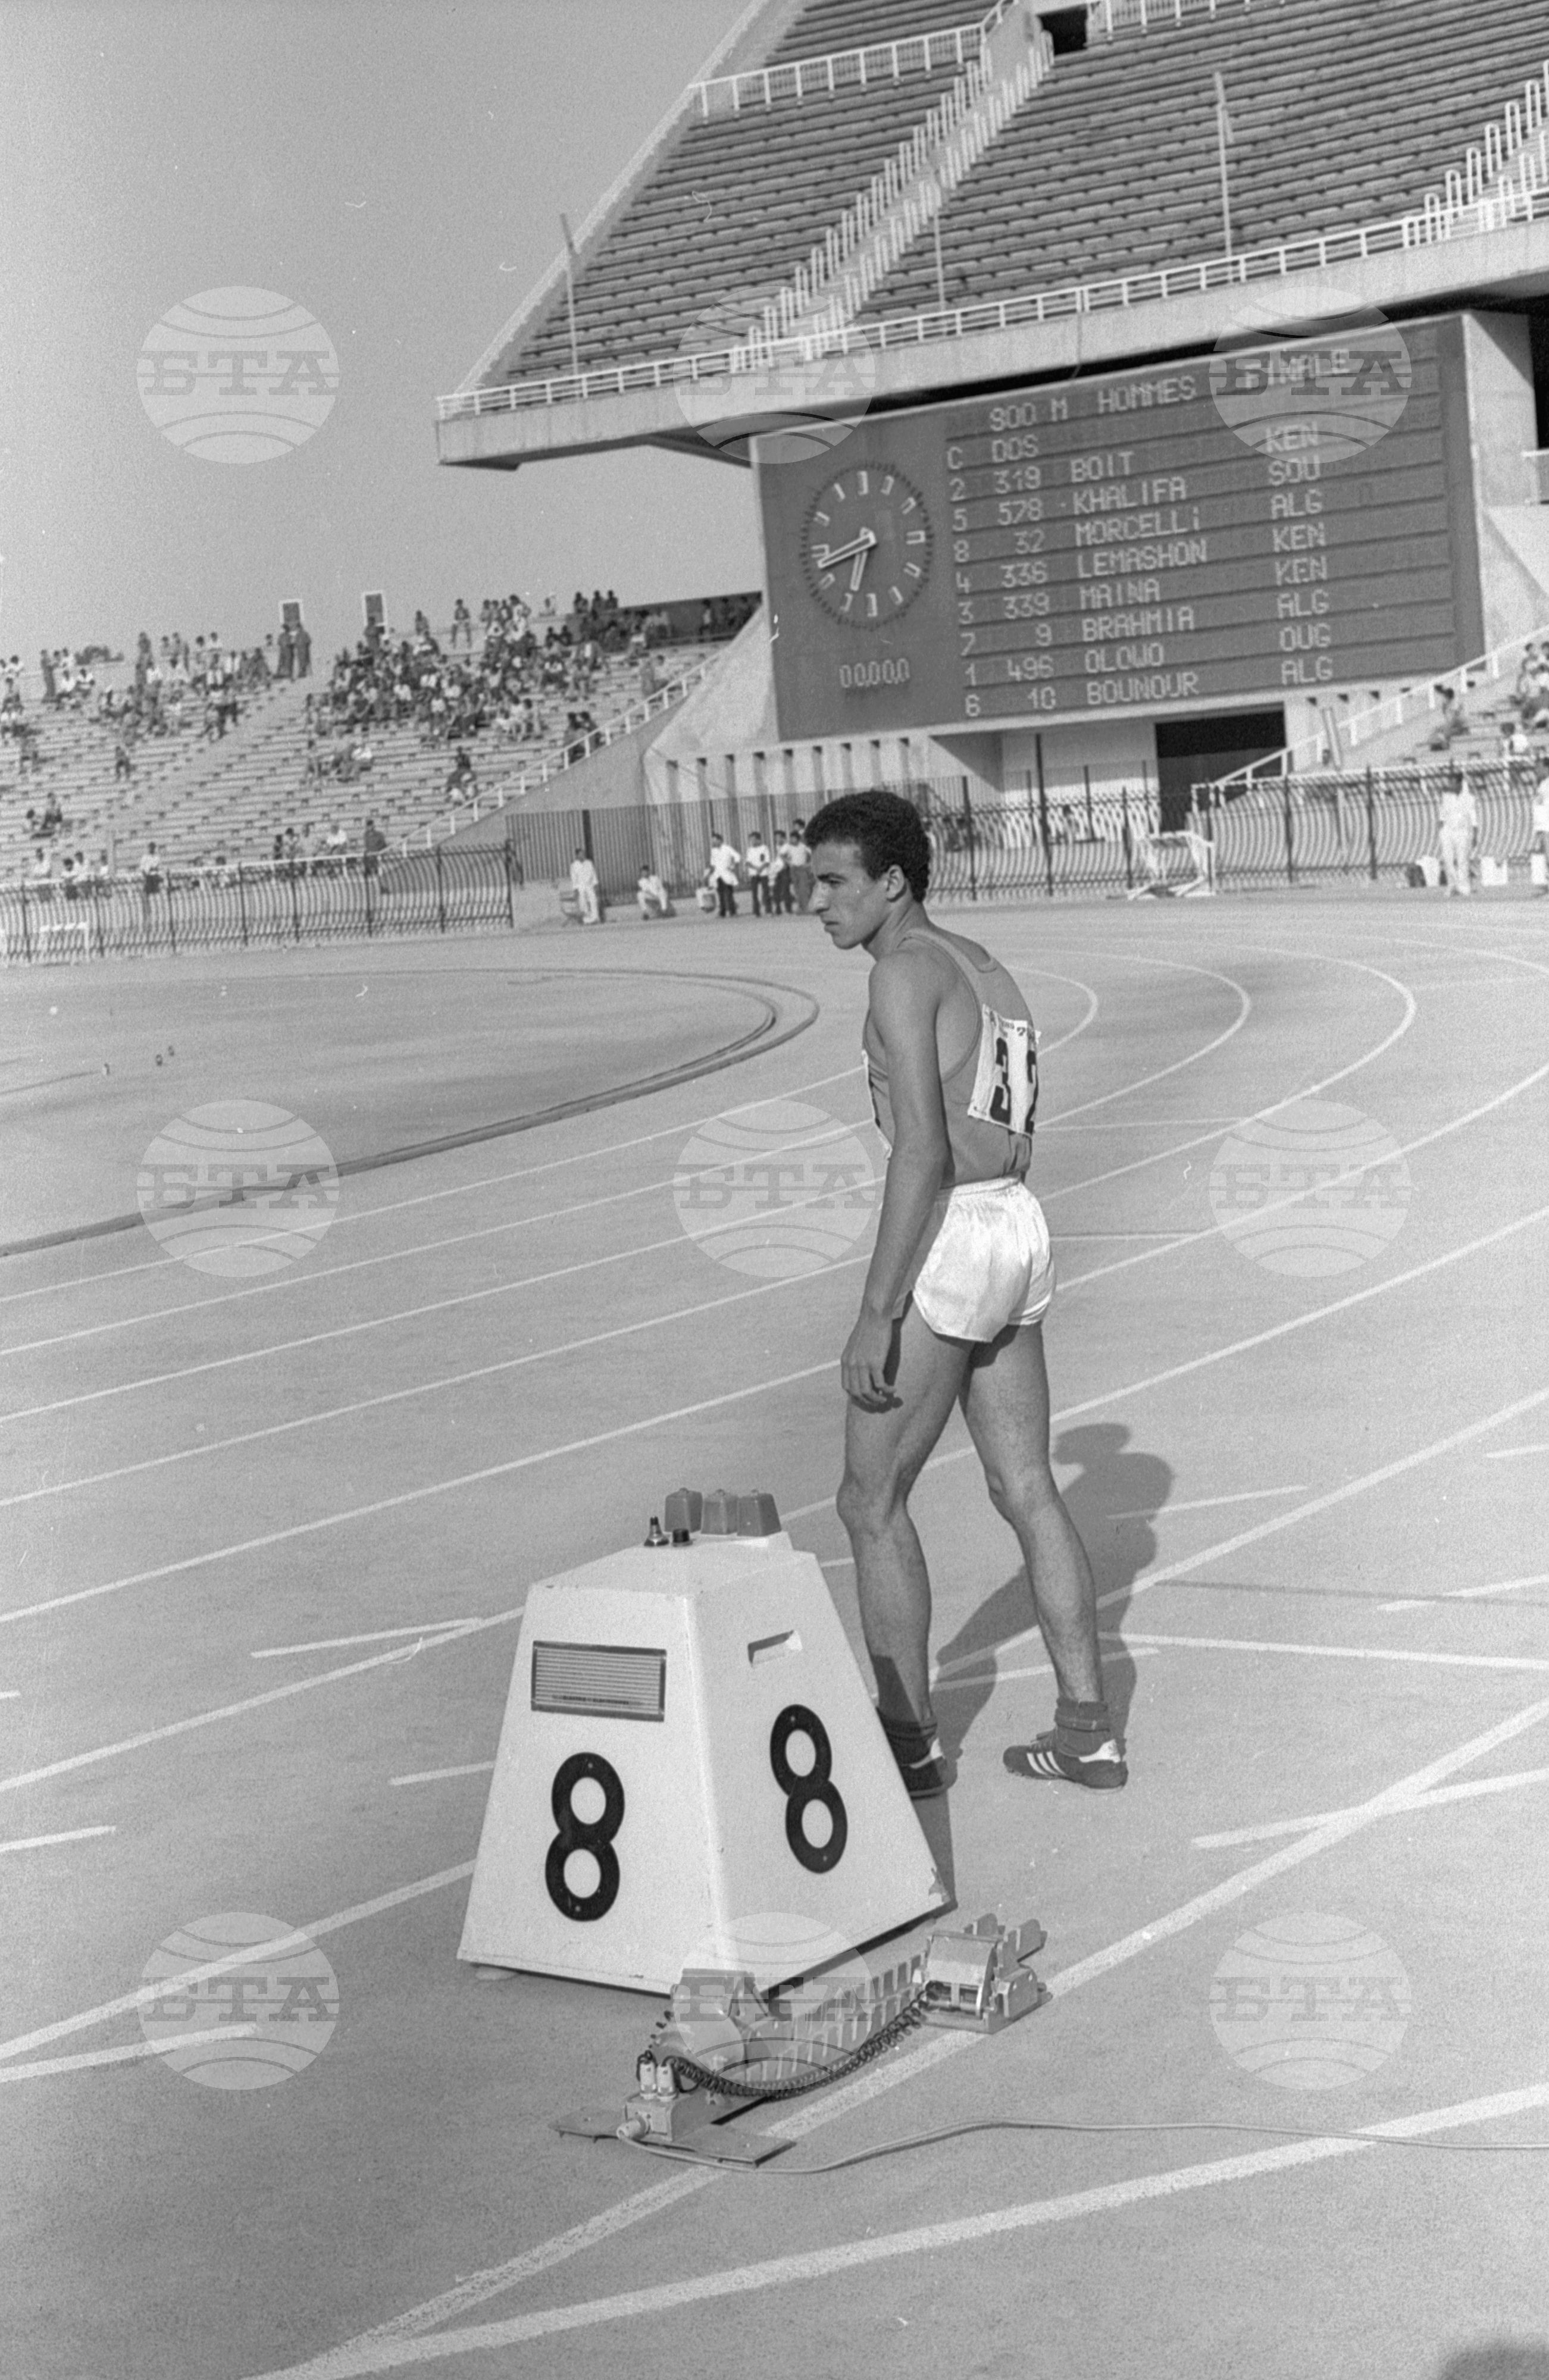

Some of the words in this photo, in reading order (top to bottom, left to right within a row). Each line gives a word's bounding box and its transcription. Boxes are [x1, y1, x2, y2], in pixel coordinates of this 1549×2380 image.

[1051, 397, 1068, 421] M
[1098, 376, 1196, 414] HOMMES
[947, 447, 963, 469] C
[950, 478, 965, 501] 2
[994, 466, 1041, 494] 319
[1072, 451, 1133, 483] BOIT
[1266, 421, 1318, 453] KEN
[953, 509, 968, 531] 5
[998, 498, 1043, 525] 578
[1073, 477, 1187, 515] KHALIFA
[1269, 455, 1320, 486] SOU
[954, 540, 969, 562] 8
[1015, 530, 1044, 554] 32
[1271, 489, 1322, 519] ALG
[956, 572, 971, 593] 4
[1000, 562, 1047, 588] 336
[1077, 539, 1207, 578] LEMASHON
[1272, 522, 1326, 552] KEN
[958, 602, 973, 624] 3
[1003, 593, 1049, 619] 339
[1079, 579, 1160, 610] MAINA
[1275, 555, 1327, 585] KEN
[960, 632, 975, 656] 7
[1036, 624, 1052, 646] 9
[1082, 606, 1194, 641] BRAHMIA
[1278, 589, 1329, 619] ALG
[965, 663, 977, 686] 1
[1085, 643, 1164, 674] OLOWO
[1280, 622, 1331, 652] OUG
[965, 694, 981, 716] 6
[1087, 671, 1198, 705] BOUNOUR
[1281, 656, 1332, 685] ALG
[769, 1703, 848, 1874] 8
[545, 1752, 625, 1921] 8
